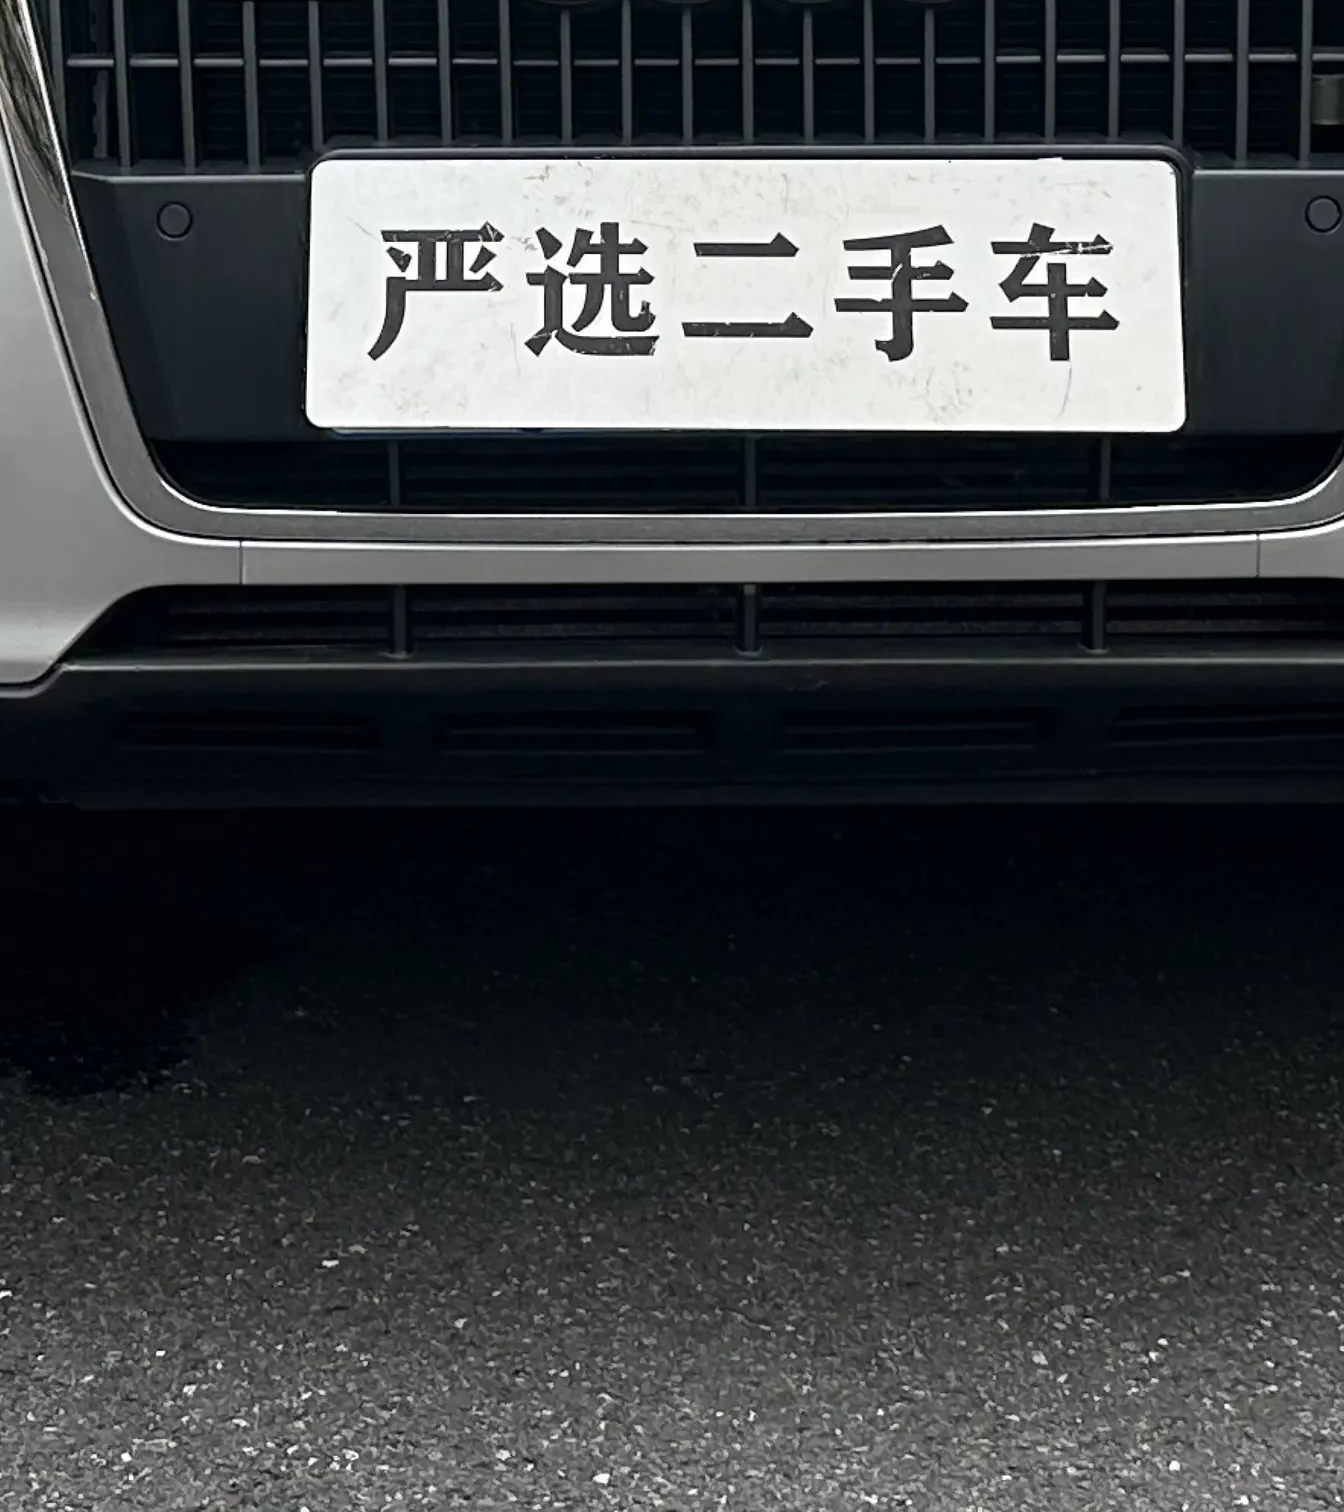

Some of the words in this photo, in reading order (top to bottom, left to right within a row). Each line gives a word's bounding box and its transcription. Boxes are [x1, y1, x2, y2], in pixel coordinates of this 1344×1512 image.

[367, 221, 1120, 362] 严选二手车
